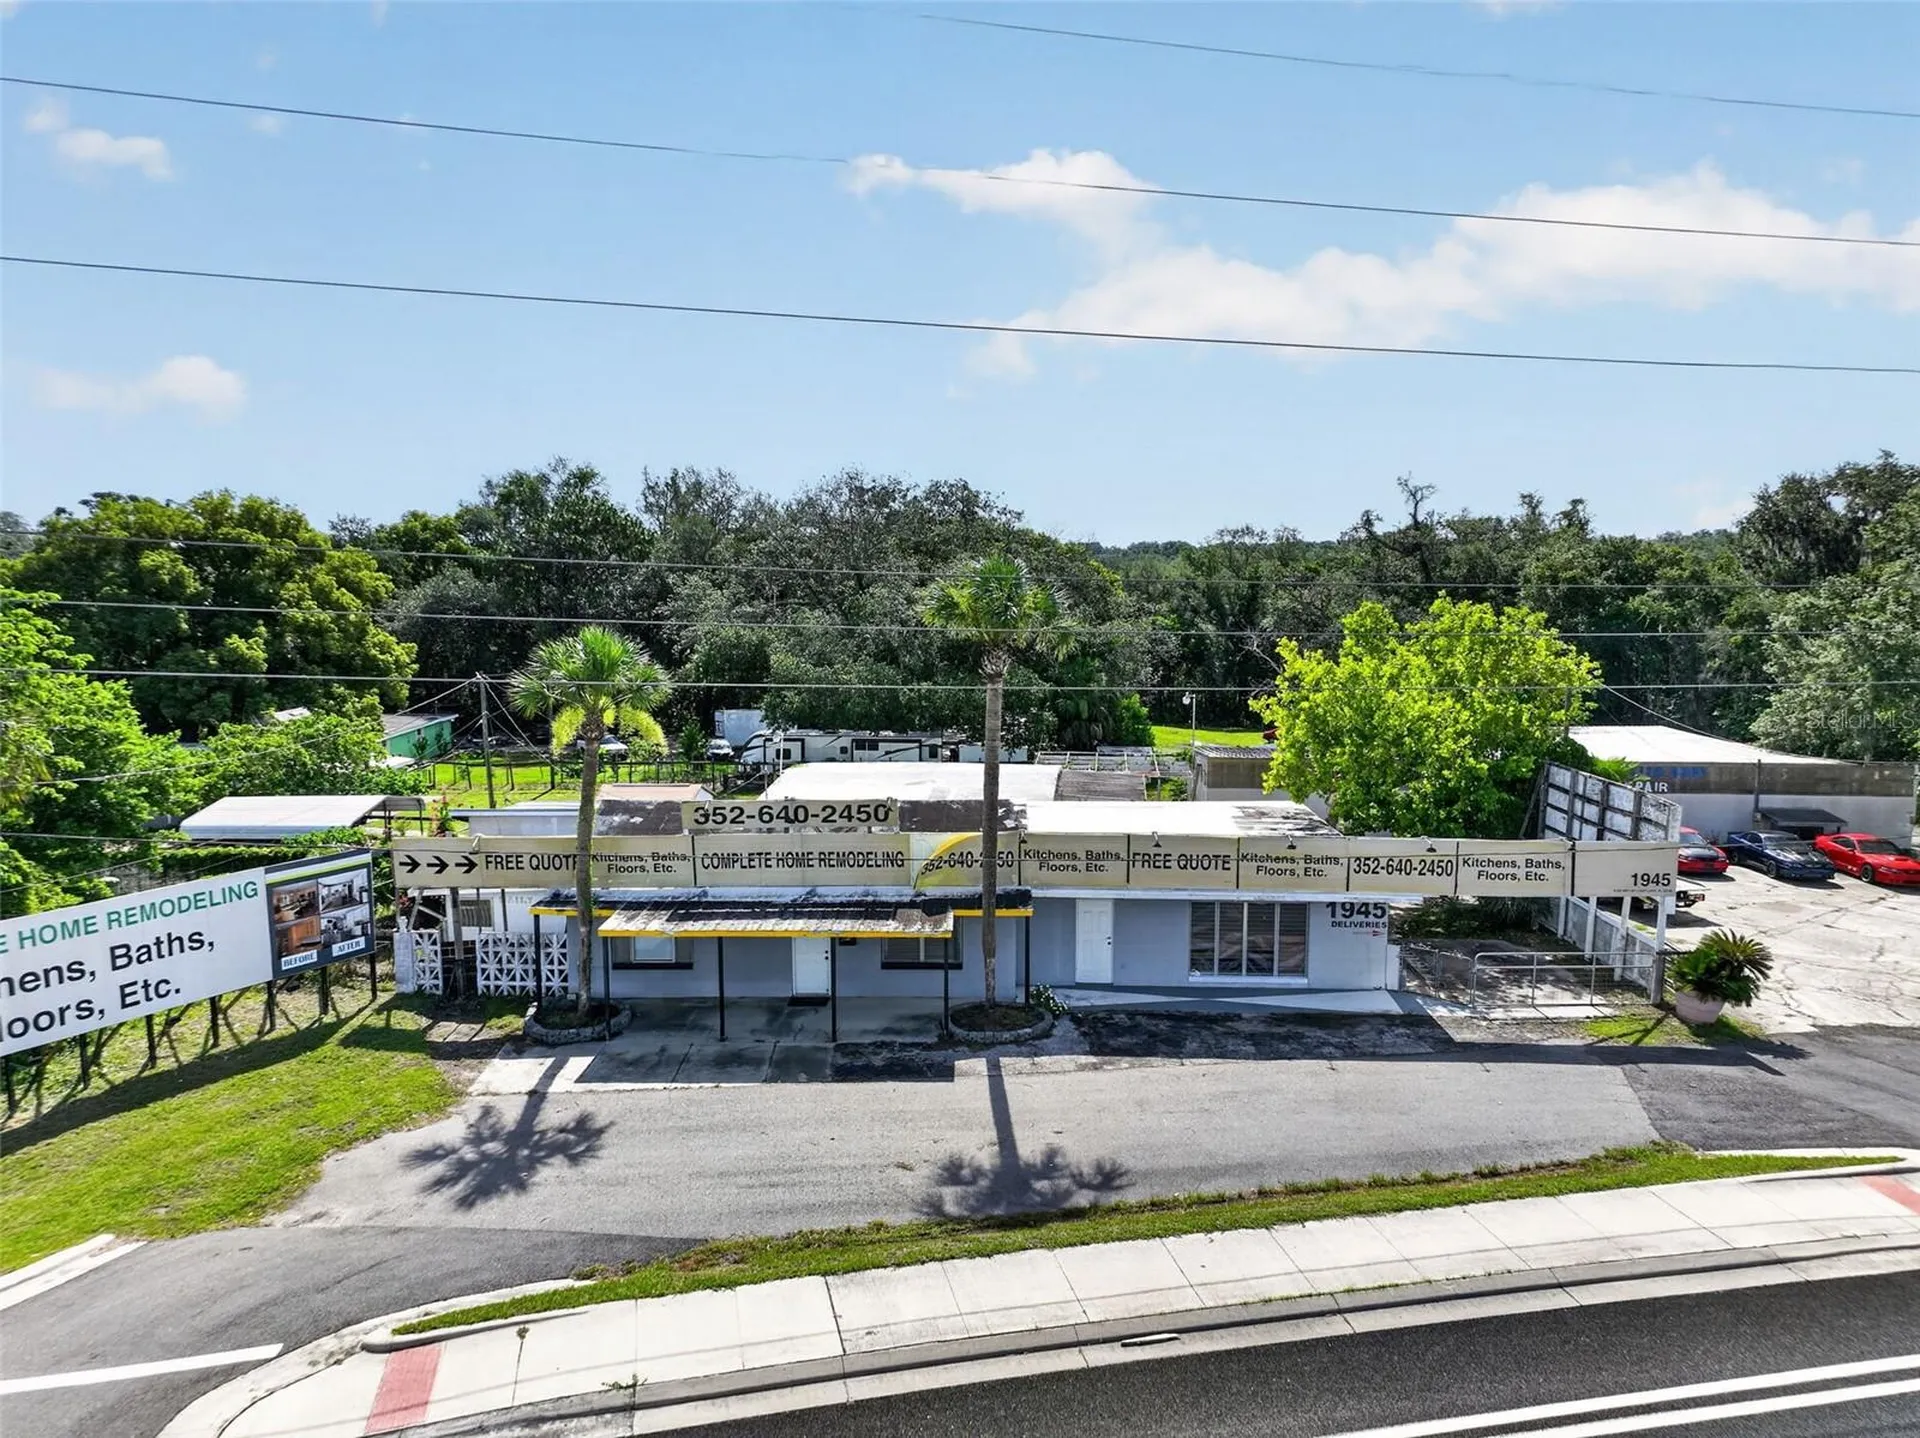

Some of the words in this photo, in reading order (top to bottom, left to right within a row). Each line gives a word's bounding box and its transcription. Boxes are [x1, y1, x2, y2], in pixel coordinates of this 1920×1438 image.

[1625, 781, 1669, 793] PAIR
[693, 804, 891, 826] 352-640-2450
[485, 855, 524, 870] FREE
[591, 852, 648, 863] Kitchens,
[651, 852, 691, 863] Baths,
[701, 852, 773, 869] COMPLETE
[775, 851, 815, 868] HOME
[817, 851, 905, 868] REMODELING
[921, 851, 1014, 875] 352-640-50
[1024, 850, 1081, 862] Kitchens,
[1085, 850, 1124, 861] Baths,
[1132, 853, 1172, 869] FREE
[1177, 854, 1231, 871] QUOTE
[1241, 853, 1300, 865] Kitchens,
[1303, 854, 1344, 867] Baths,
[607, 863, 650, 873] Floors,
[653, 863, 677, 873] Etc.
[1039, 862, 1082, 873] Floors,
[1085, 862, 1109, 873] Etc.
[1353, 857, 1454, 877] 352-640-2450
[1462, 857, 1521, 869] Kitchens,
[1525, 858, 1566, 870] Baths,
[1256, 866, 1300, 878] Floors,
[1303, 867, 1328, 878] Etc.
[1477, 870, 1521, 882] Floors,
[1525, 870, 1549, 882] Etc.
[1631, 873, 1671, 887] 1945
[18, 915, 99, 949] HOME
[106, 881, 259, 930] REMODELING
[1326, 901, 1387, 919] 1945
[1331, 920, 1387, 929] DELIVERIES
[109, 930, 215, 972] Baths,
[337, 941, 362, 954] AFTER
[283, 952, 315, 968] BEFORE
[118, 976, 182, 1010] Etc.
